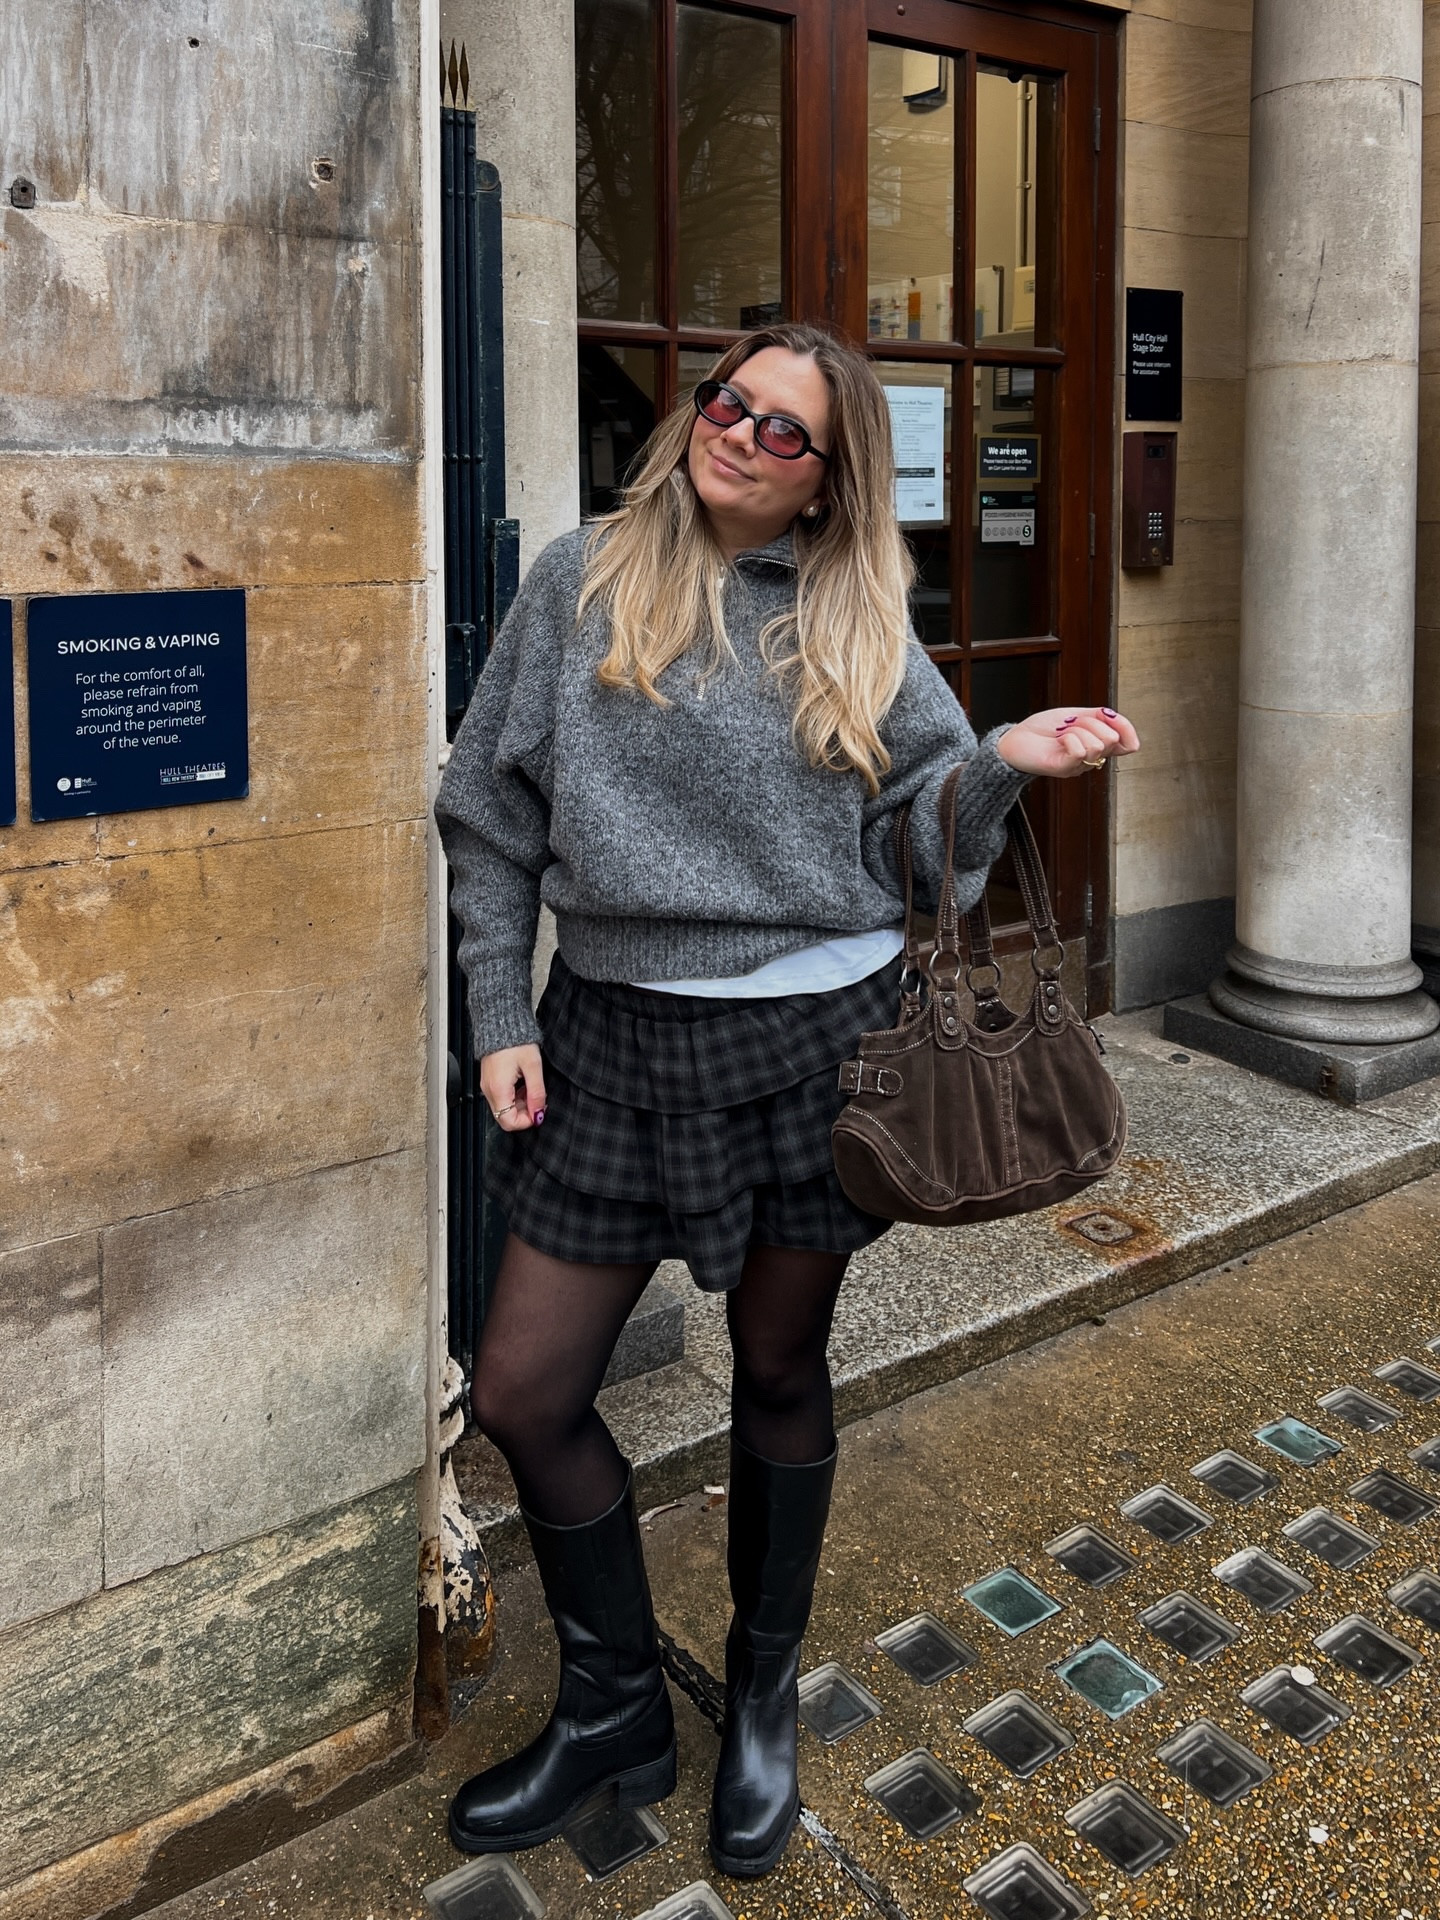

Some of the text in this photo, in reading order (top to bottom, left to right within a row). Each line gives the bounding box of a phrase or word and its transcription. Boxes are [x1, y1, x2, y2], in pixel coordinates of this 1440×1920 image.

[1132, 333, 1168, 344] Hull City Hall
[1132, 343, 1164, 354] Stage Door
[988, 446, 999, 455] We
[1011, 448, 1027, 457] open
[1024, 526, 1030, 536] 5
[57, 632, 220, 655] SMOKING & VAPING
[76, 665, 205, 685] For the comfort of all,
[83, 682, 198, 704] please refrain from
[81, 699, 201, 718] smoking and vaping
[76, 714, 206, 736] around the perimeter
[103, 733, 182, 750] of the venue.
[160, 762, 226, 777] HULL THEATRES
